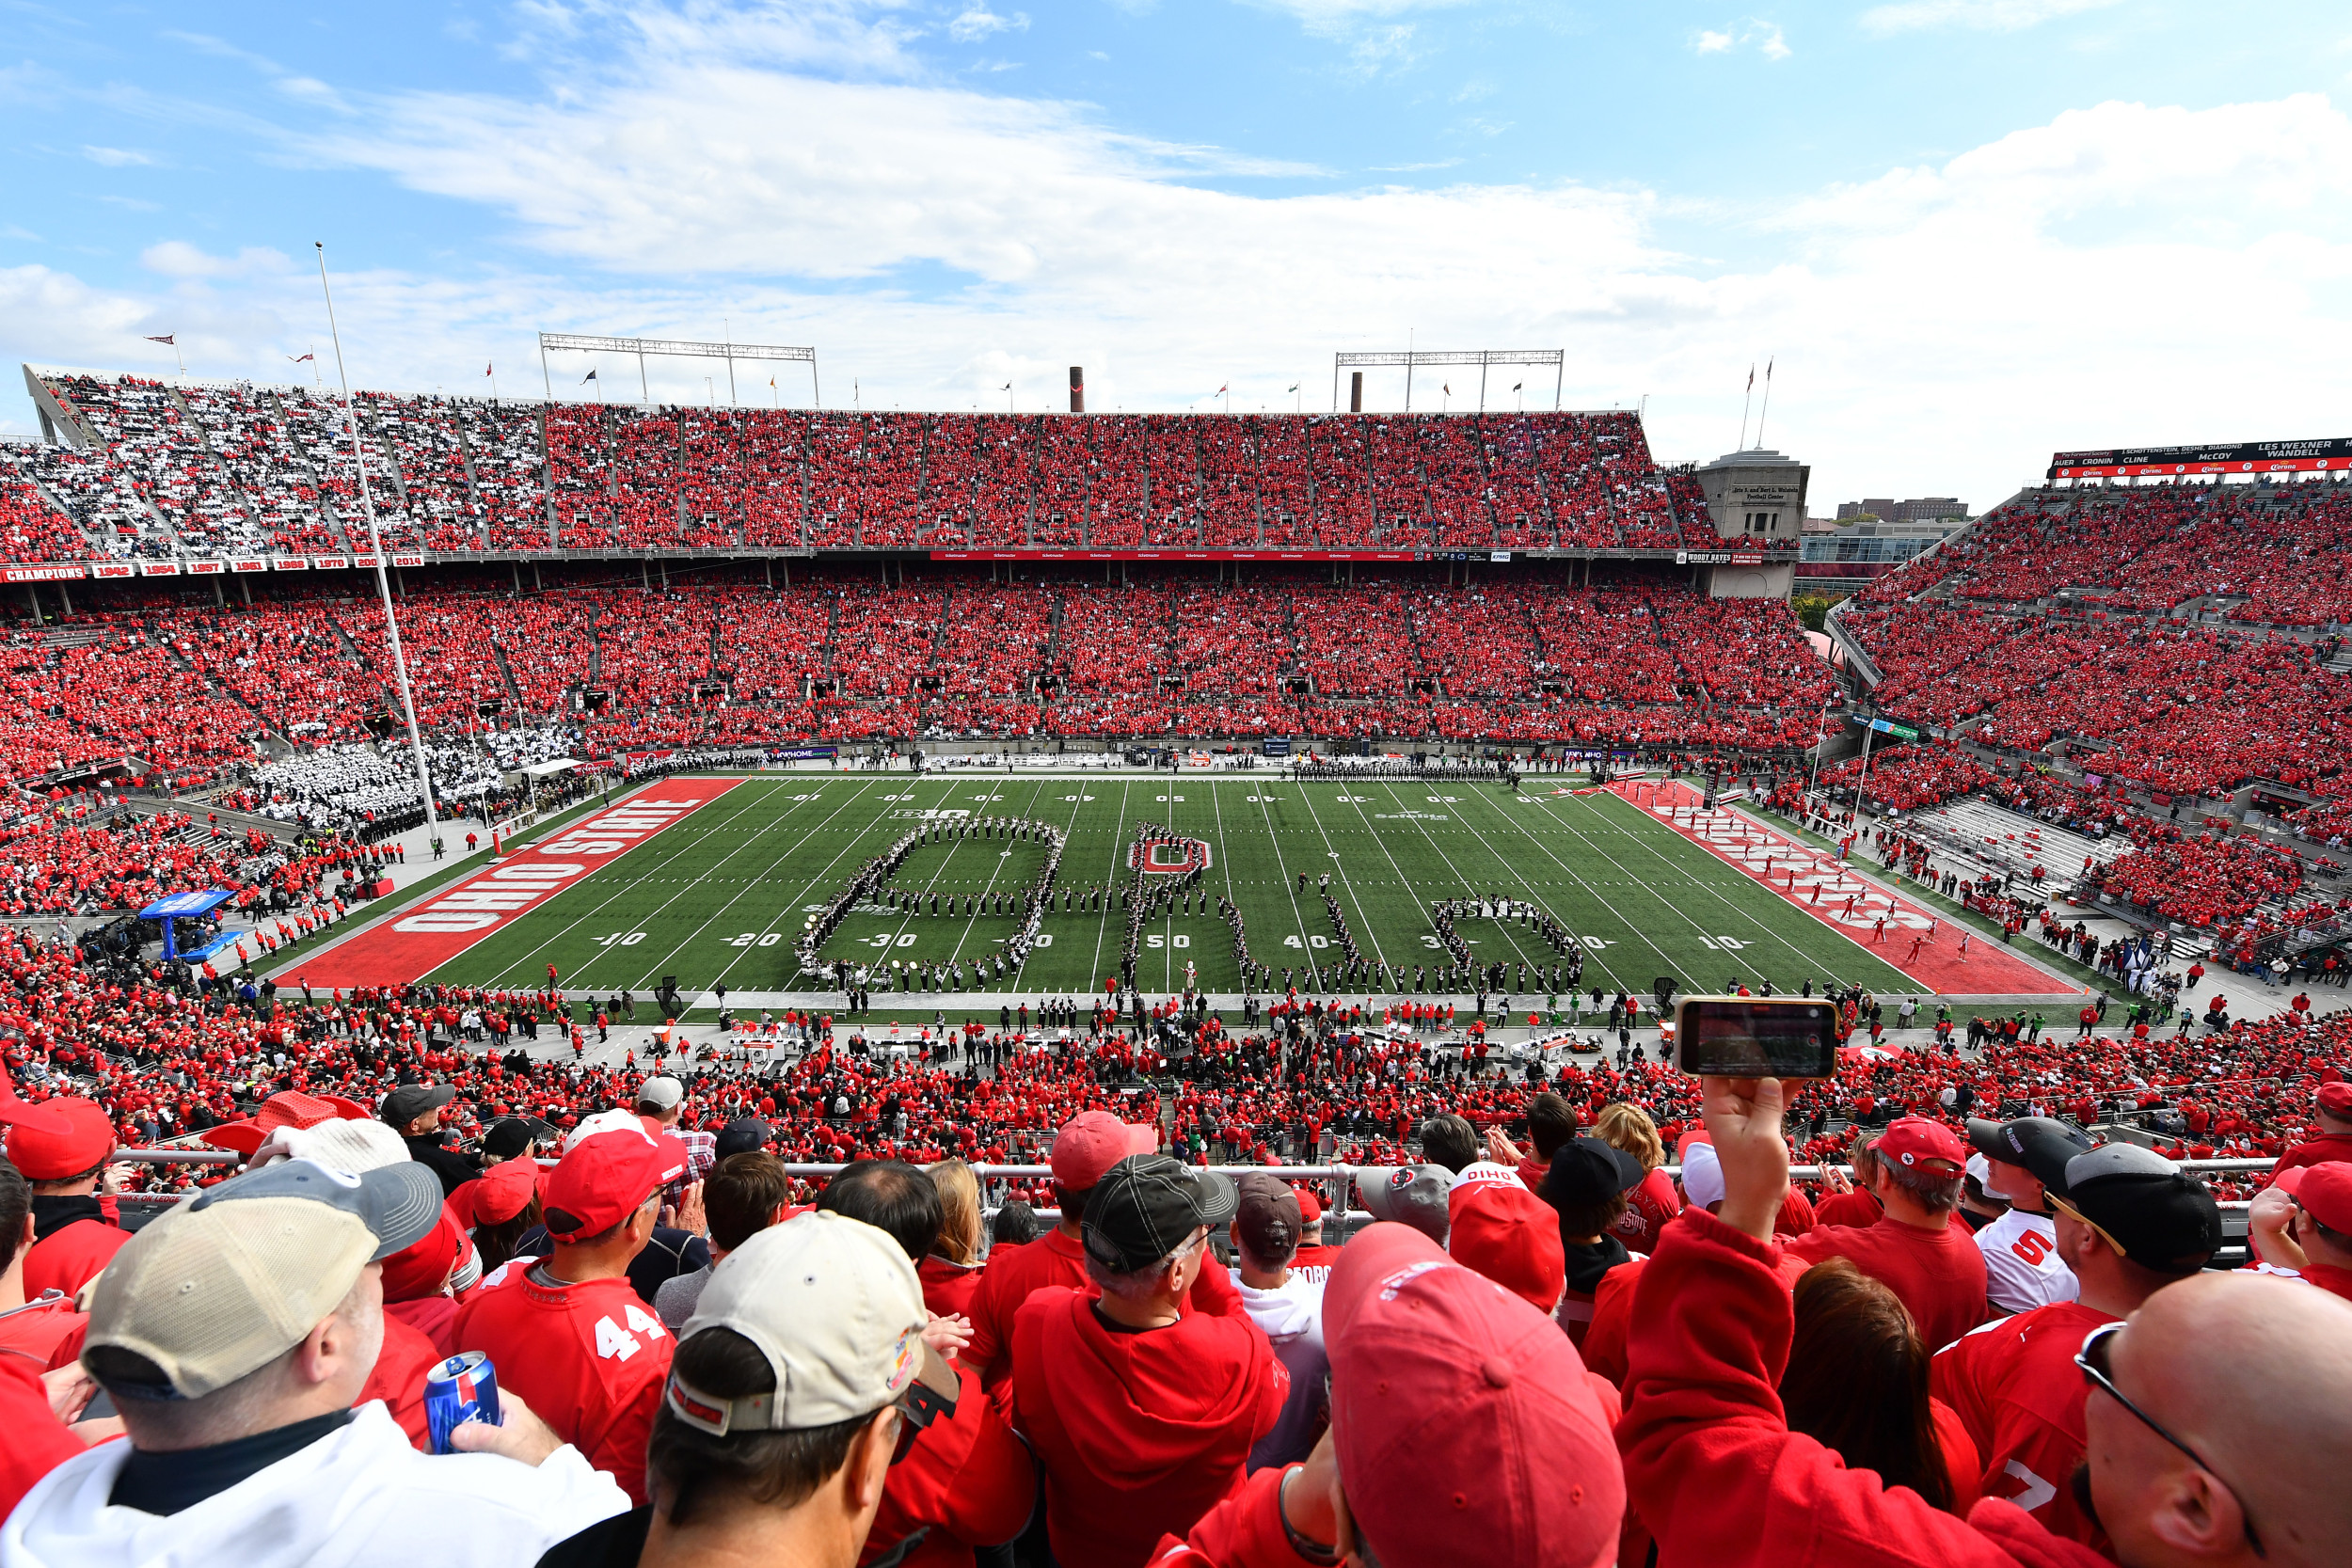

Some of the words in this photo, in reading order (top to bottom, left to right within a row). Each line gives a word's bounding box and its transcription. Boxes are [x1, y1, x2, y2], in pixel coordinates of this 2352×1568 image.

[2281, 441, 2331, 450] WEXNER
[2267, 449, 2321, 457] WANDELL
[192, 563, 219, 573] 1957
[318, 559, 344, 568] 1970
[395, 557, 421, 565] 2014
[7, 566, 84, 580] CHAMPIONS
[99, 567, 129, 576] 1942
[147, 565, 176, 574] 1954
[1704, 773, 1716, 801] BUCKEYES
[2268, 797, 2298, 809] HONDA
[1375, 812, 1448, 820] Safelite
[537, 799, 703, 855] STATE
[390, 863, 586, 932] OHIO
[599, 932, 648, 946] 10
[729, 932, 783, 947] 20
[869, 933, 918, 948] 30
[1146, 934, 1190, 949] 50
[1283, 934, 1329, 949] 40
[1697, 935, 1740, 950] 10
[252, 1088, 262, 1097] 17
[1468, 1169, 1511, 1180] OHIO
[1625, 1211, 1647, 1237] STATE
[2011, 1228, 2054, 1266] 5
[595, 1304, 666, 1362] 44
